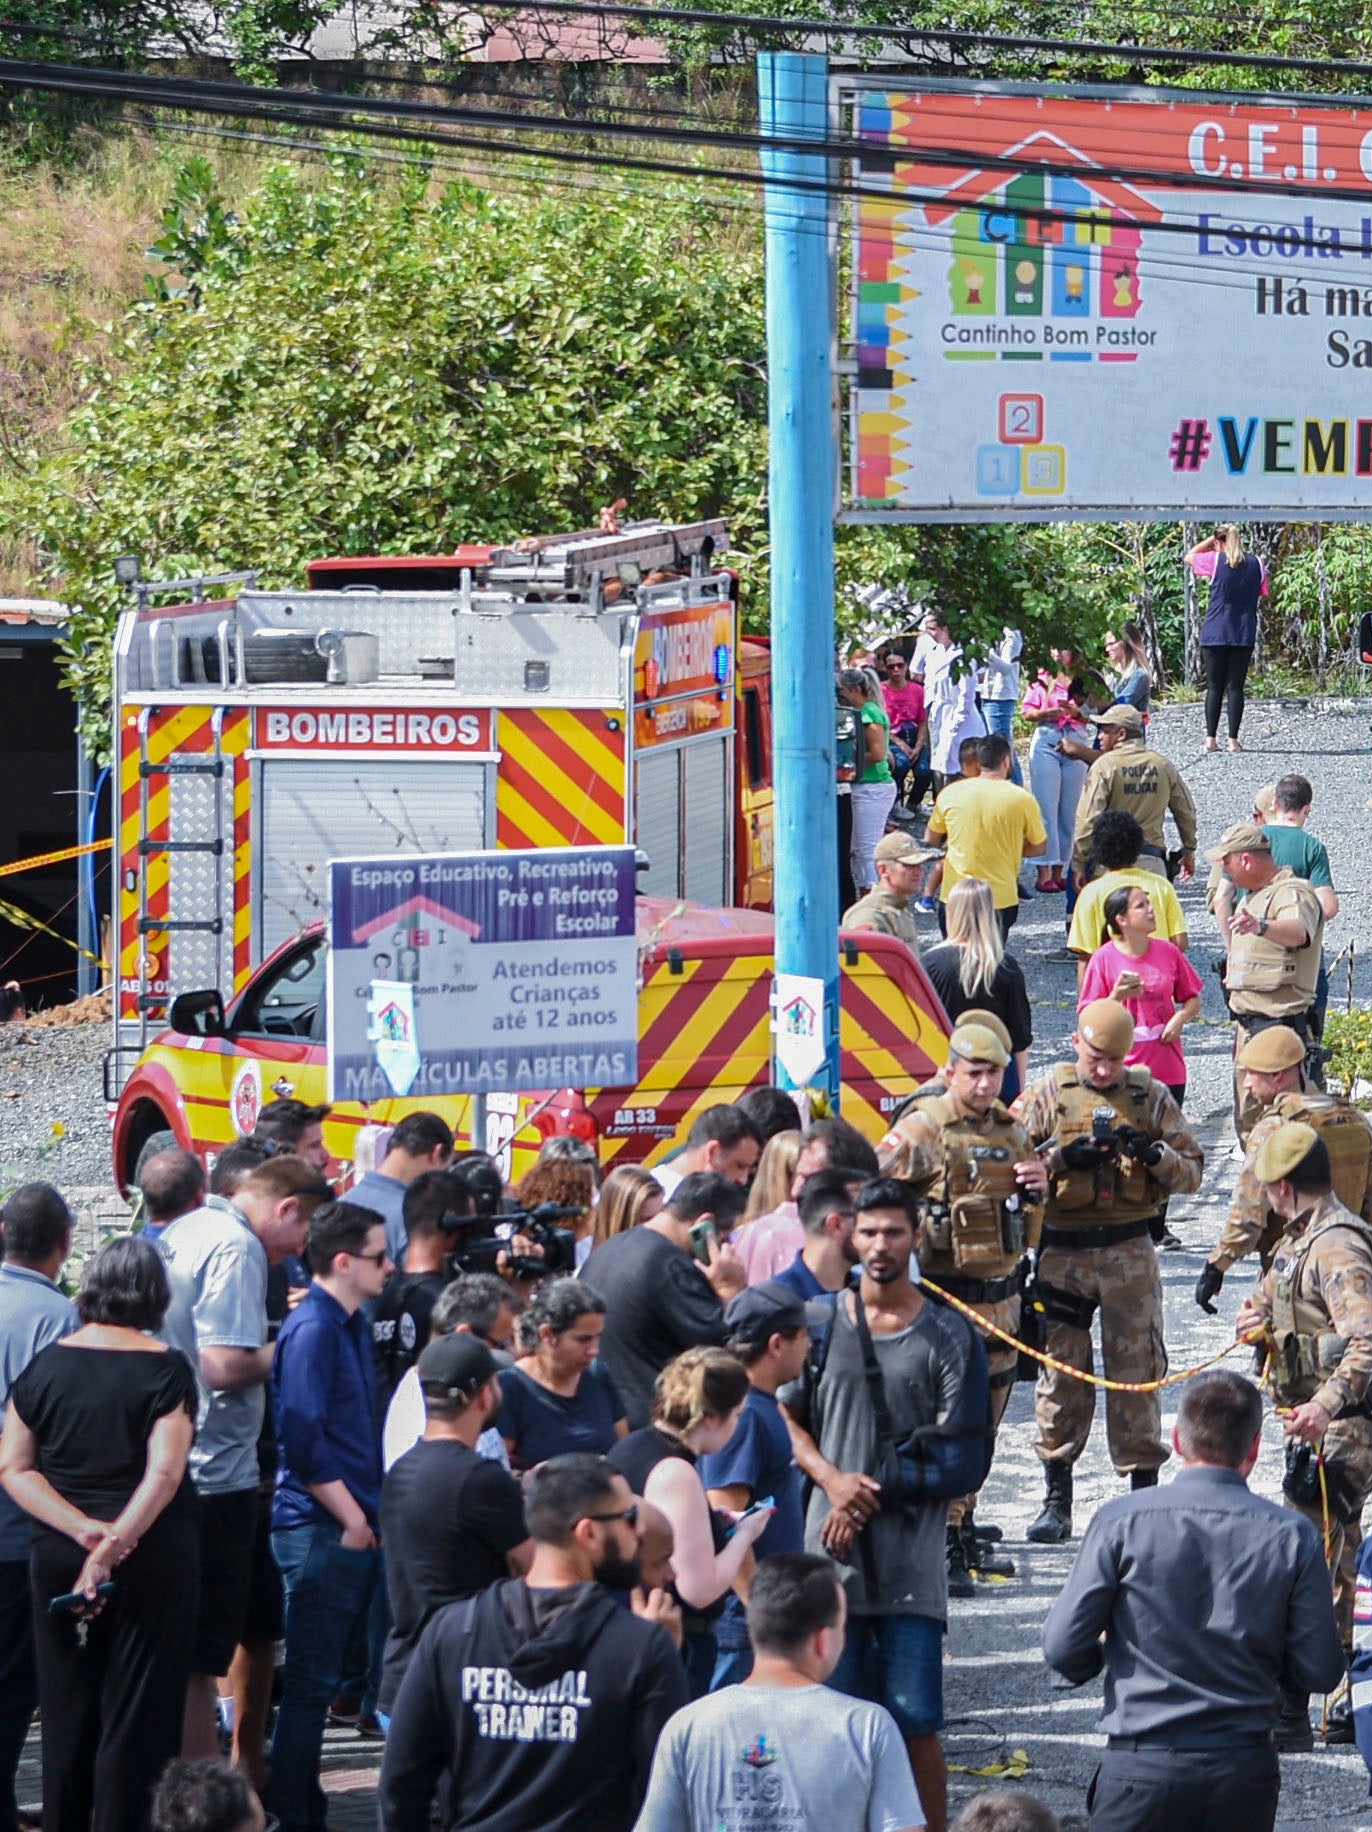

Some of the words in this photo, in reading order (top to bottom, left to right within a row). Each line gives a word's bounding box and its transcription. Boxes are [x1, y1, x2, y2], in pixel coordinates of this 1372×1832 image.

[1186, 120, 1336, 181] C.E.I.
[1197, 212, 1343, 260] Escola
[1255, 277, 1310, 316] Há
[940, 322, 1037, 344] Cantinho
[1043, 325, 1089, 345] Bom
[1095, 325, 1157, 346] Pastor
[1011, 405, 1031, 433] 2
[266, 713, 481, 745] BOMBEIROS
[350, 866, 415, 889] Espaço
[419, 863, 514, 884] Educativo,
[518, 859, 619, 877] Recreativo,
[497, 889, 528, 906] Pré
[532, 892, 544, 905] e
[549, 886, 619, 908] Reforço
[555, 914, 619, 932] Escolar
[492, 957, 617, 980] Atendemos
[441, 982, 478, 995] Pastor
[509, 982, 601, 1006] Crianças
[492, 1011, 527, 1031] até
[536, 1010, 559, 1027] 12
[566, 1009, 618, 1027] anos
[346, 1059, 509, 1090] MAÍCULAS
[515, 1052, 626, 1080] ABERTAS
[636, 1108, 656, 1124] 33
